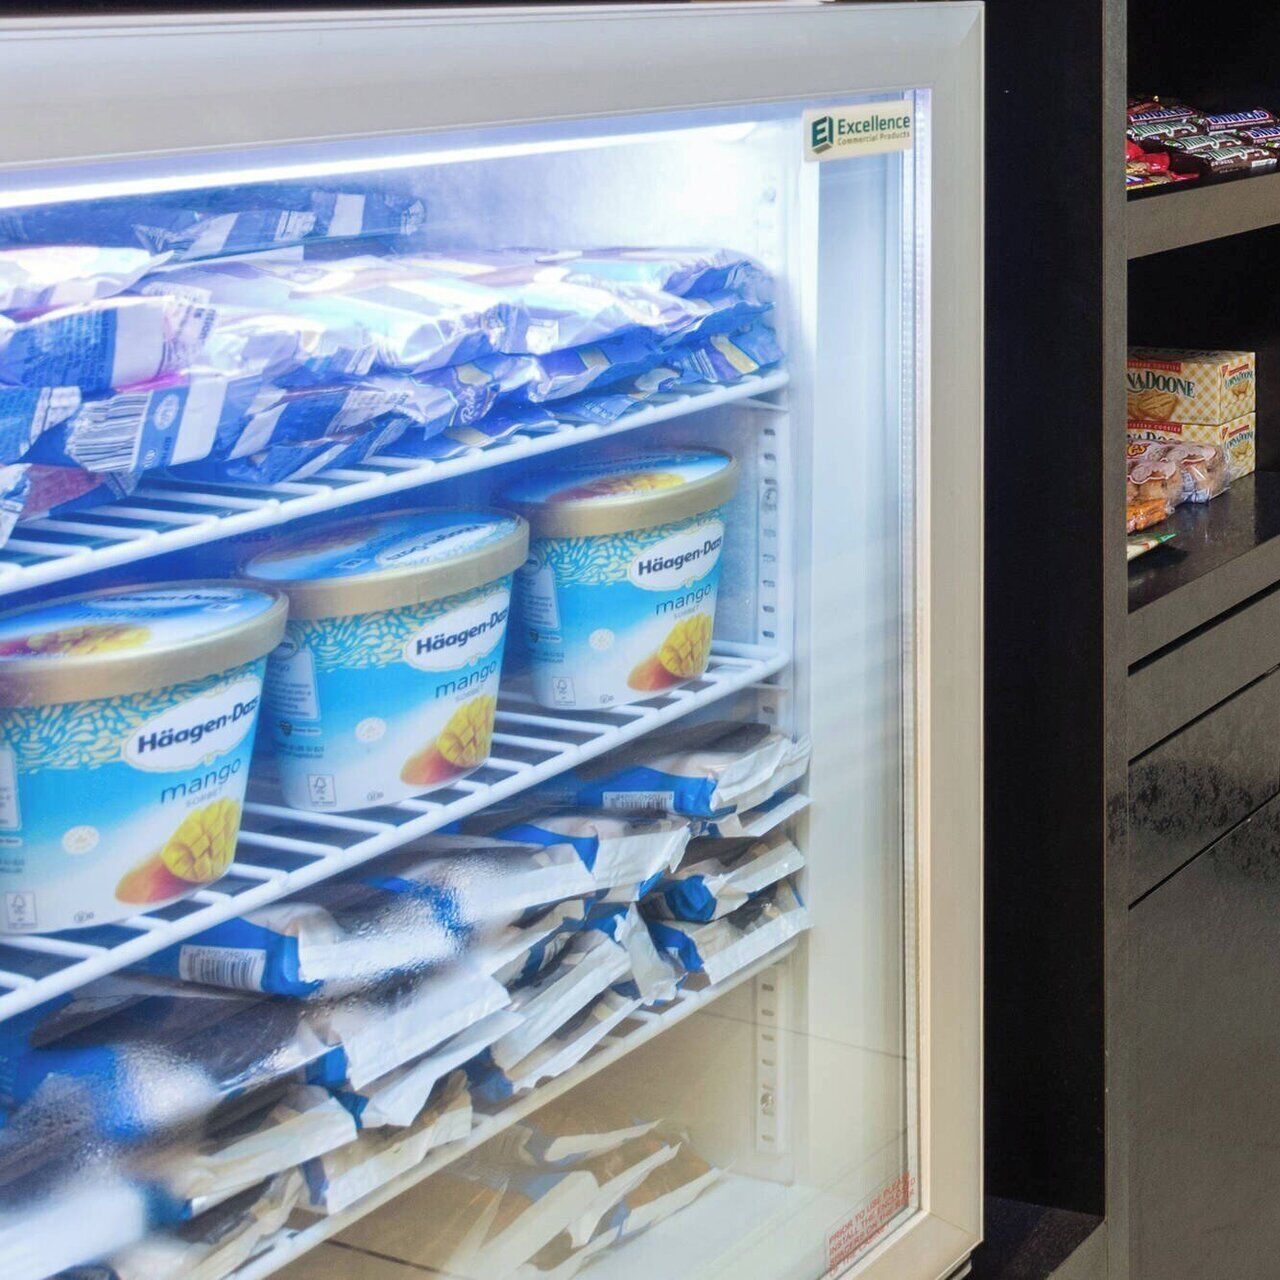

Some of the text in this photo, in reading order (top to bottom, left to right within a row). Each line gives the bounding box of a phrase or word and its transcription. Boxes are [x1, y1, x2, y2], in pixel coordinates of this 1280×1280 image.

[837, 114, 911, 136] Excellence
[879, 131, 911, 140] Products
[655, 582, 713, 616] mango
[434, 659, 498, 700] mango
[160, 757, 242, 804] mango
